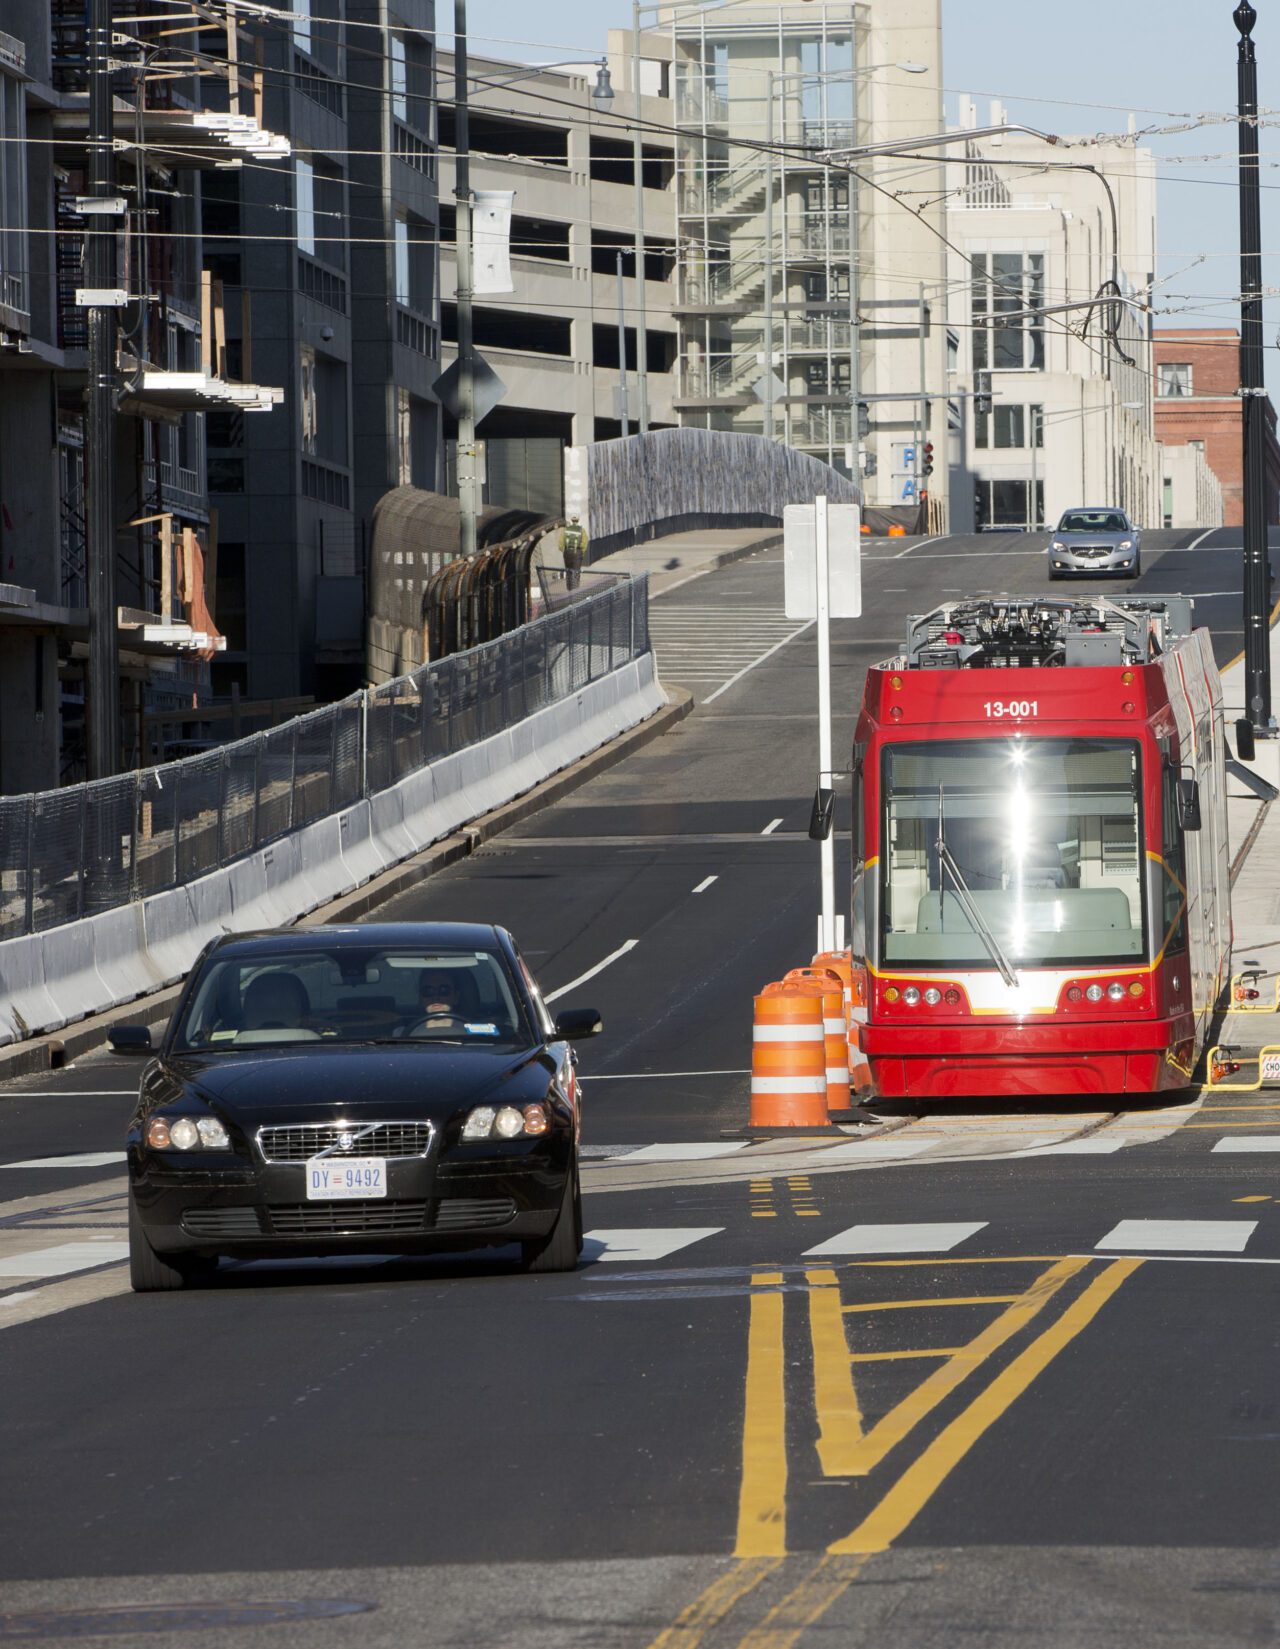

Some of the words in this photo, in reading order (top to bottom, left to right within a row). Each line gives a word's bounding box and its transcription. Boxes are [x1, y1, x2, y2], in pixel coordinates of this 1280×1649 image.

[983, 701, 1038, 717] 13-001
[312, 1169, 330, 1189] DY
[346, 1168, 381, 1188] 9492
